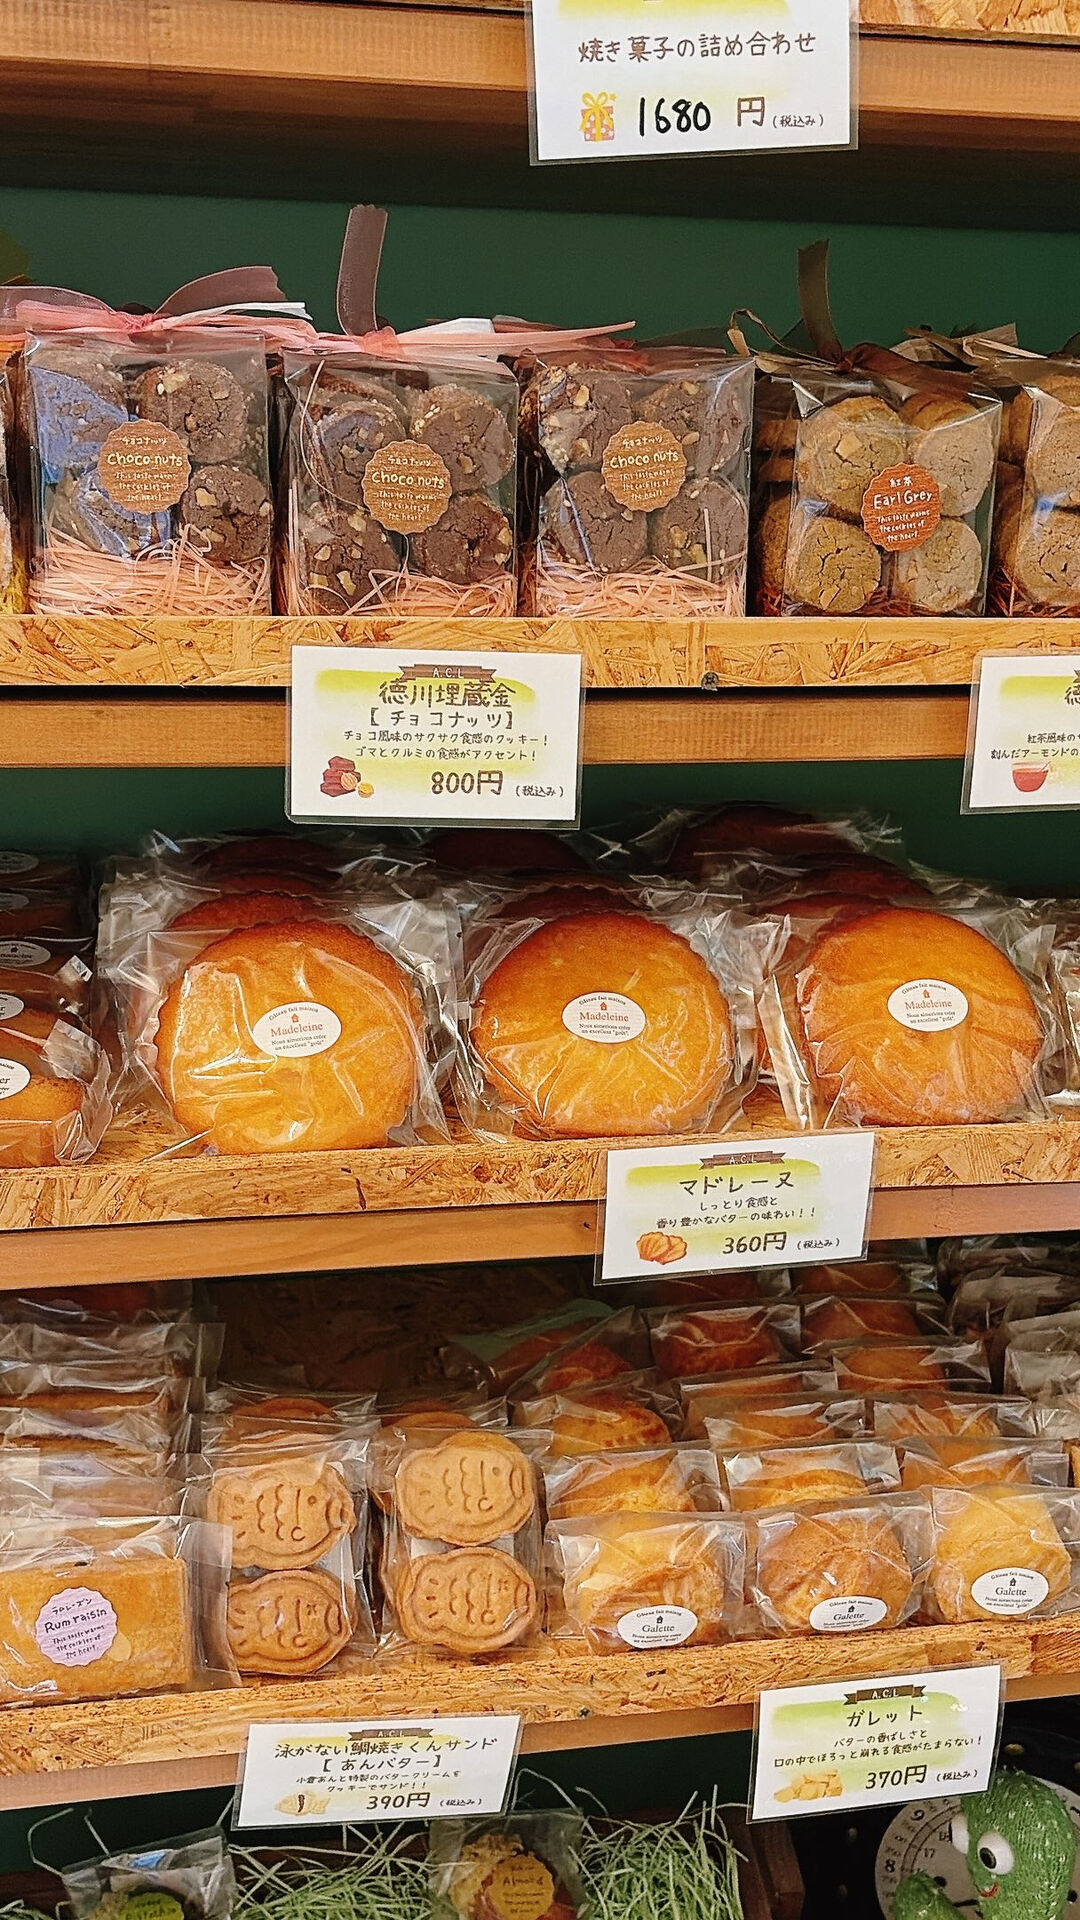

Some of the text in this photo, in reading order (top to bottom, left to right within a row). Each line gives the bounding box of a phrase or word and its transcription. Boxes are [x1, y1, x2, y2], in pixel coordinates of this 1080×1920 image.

[578, 31, 816, 63] 焼き菓子の詰め合わせ
[639, 97, 711, 137] 1680
[737, 97, 765, 127] 円
[108, 452, 183, 466] Choco nuts
[610, 449, 679, 469] Choco nuts
[372, 471, 444, 489] Choco nuts
[874, 490, 932, 509] Earl Grey
[432, 666, 465, 680] A.C.L
[378, 680, 516, 708] 徳川埋蔵金
[370, 707, 513, 729] 【チョコナッツ】
[344, 729, 549, 746] チョコ風味のサクサク食感のクッキー！
[1027, 732, 1080, 744] 紅茶風味の
[355, 746, 537, 762] ゴマとクルミの食感がアクセント！
[431, 770, 503, 795] 800円
[905, 999, 952, 1011] Madeleine
[579, 1012, 629, 1022] Madeleine
[271, 1022, 324, 1037] Madeleine
[680, 1171, 794, 1195] マドレーヌ
[700, 1196, 778, 1212] しっとり食感と
[723, 1231, 787, 1255] 360円
[995, 1587, 1027, 1596] Galette
[45, 1609, 107, 1634] Rum raisin
[834, 1613, 865, 1621] Galette
[642, 1624, 675, 1633] Galette
[872, 1688, 899, 1700] A.C.L
[847, 1704, 923, 1728] ガレット
[834, 1729, 928, 1748] バターの香ばしさと
[274, 1737, 498, 1759] 泳がない鯛焼きくんサンド
[323, 1755, 442, 1773] 【あんバター】
[865, 1765, 927, 1790] 370円
[366, 1792, 430, 1811] 390円
